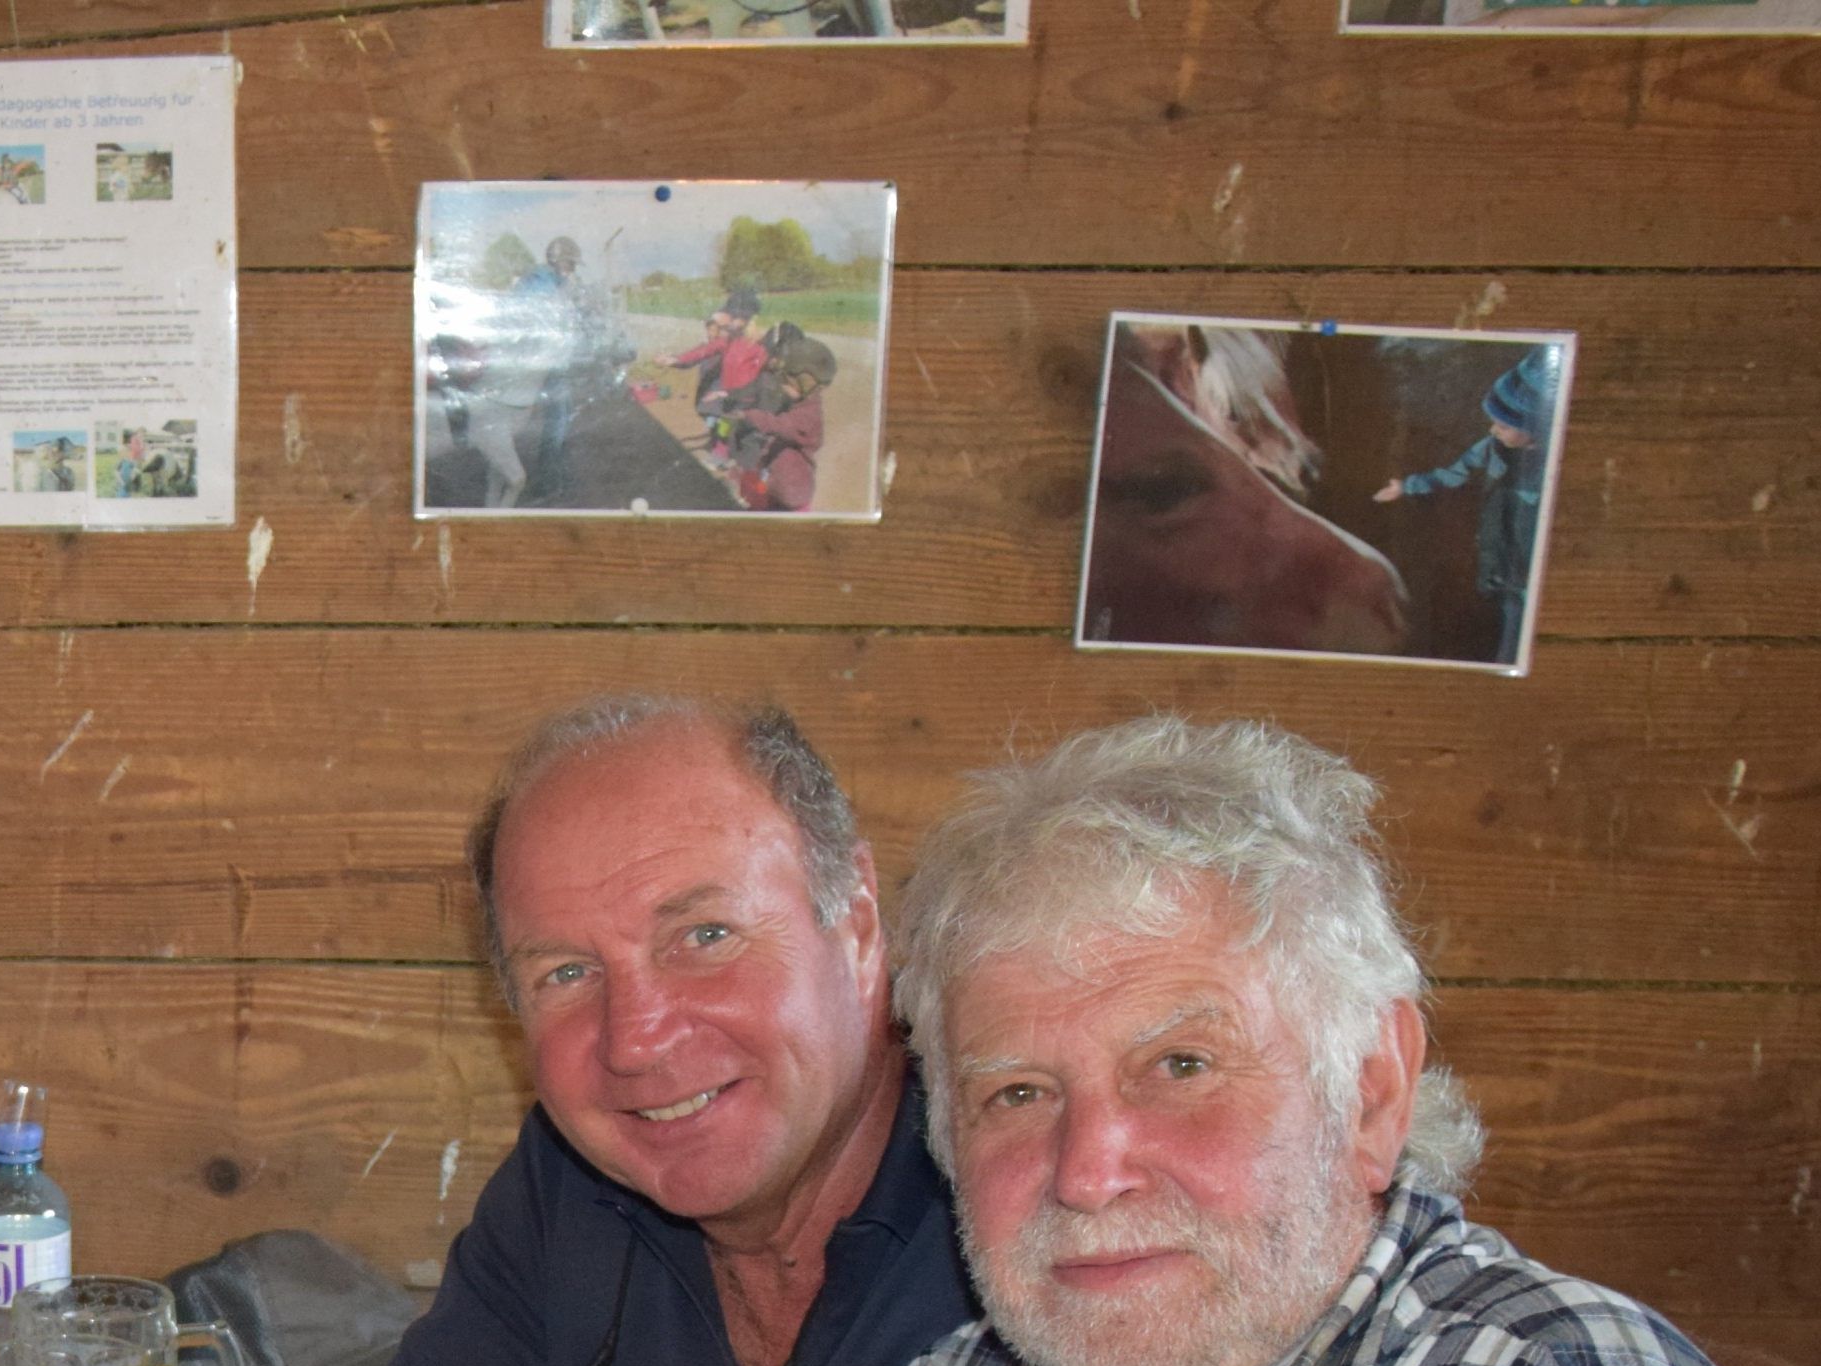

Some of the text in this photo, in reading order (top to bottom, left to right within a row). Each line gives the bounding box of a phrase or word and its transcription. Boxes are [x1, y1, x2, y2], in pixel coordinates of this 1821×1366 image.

[0, 117, 47, 129] Kinder
[53, 116, 72, 128] ab
[92, 114, 144, 127] Jahren
